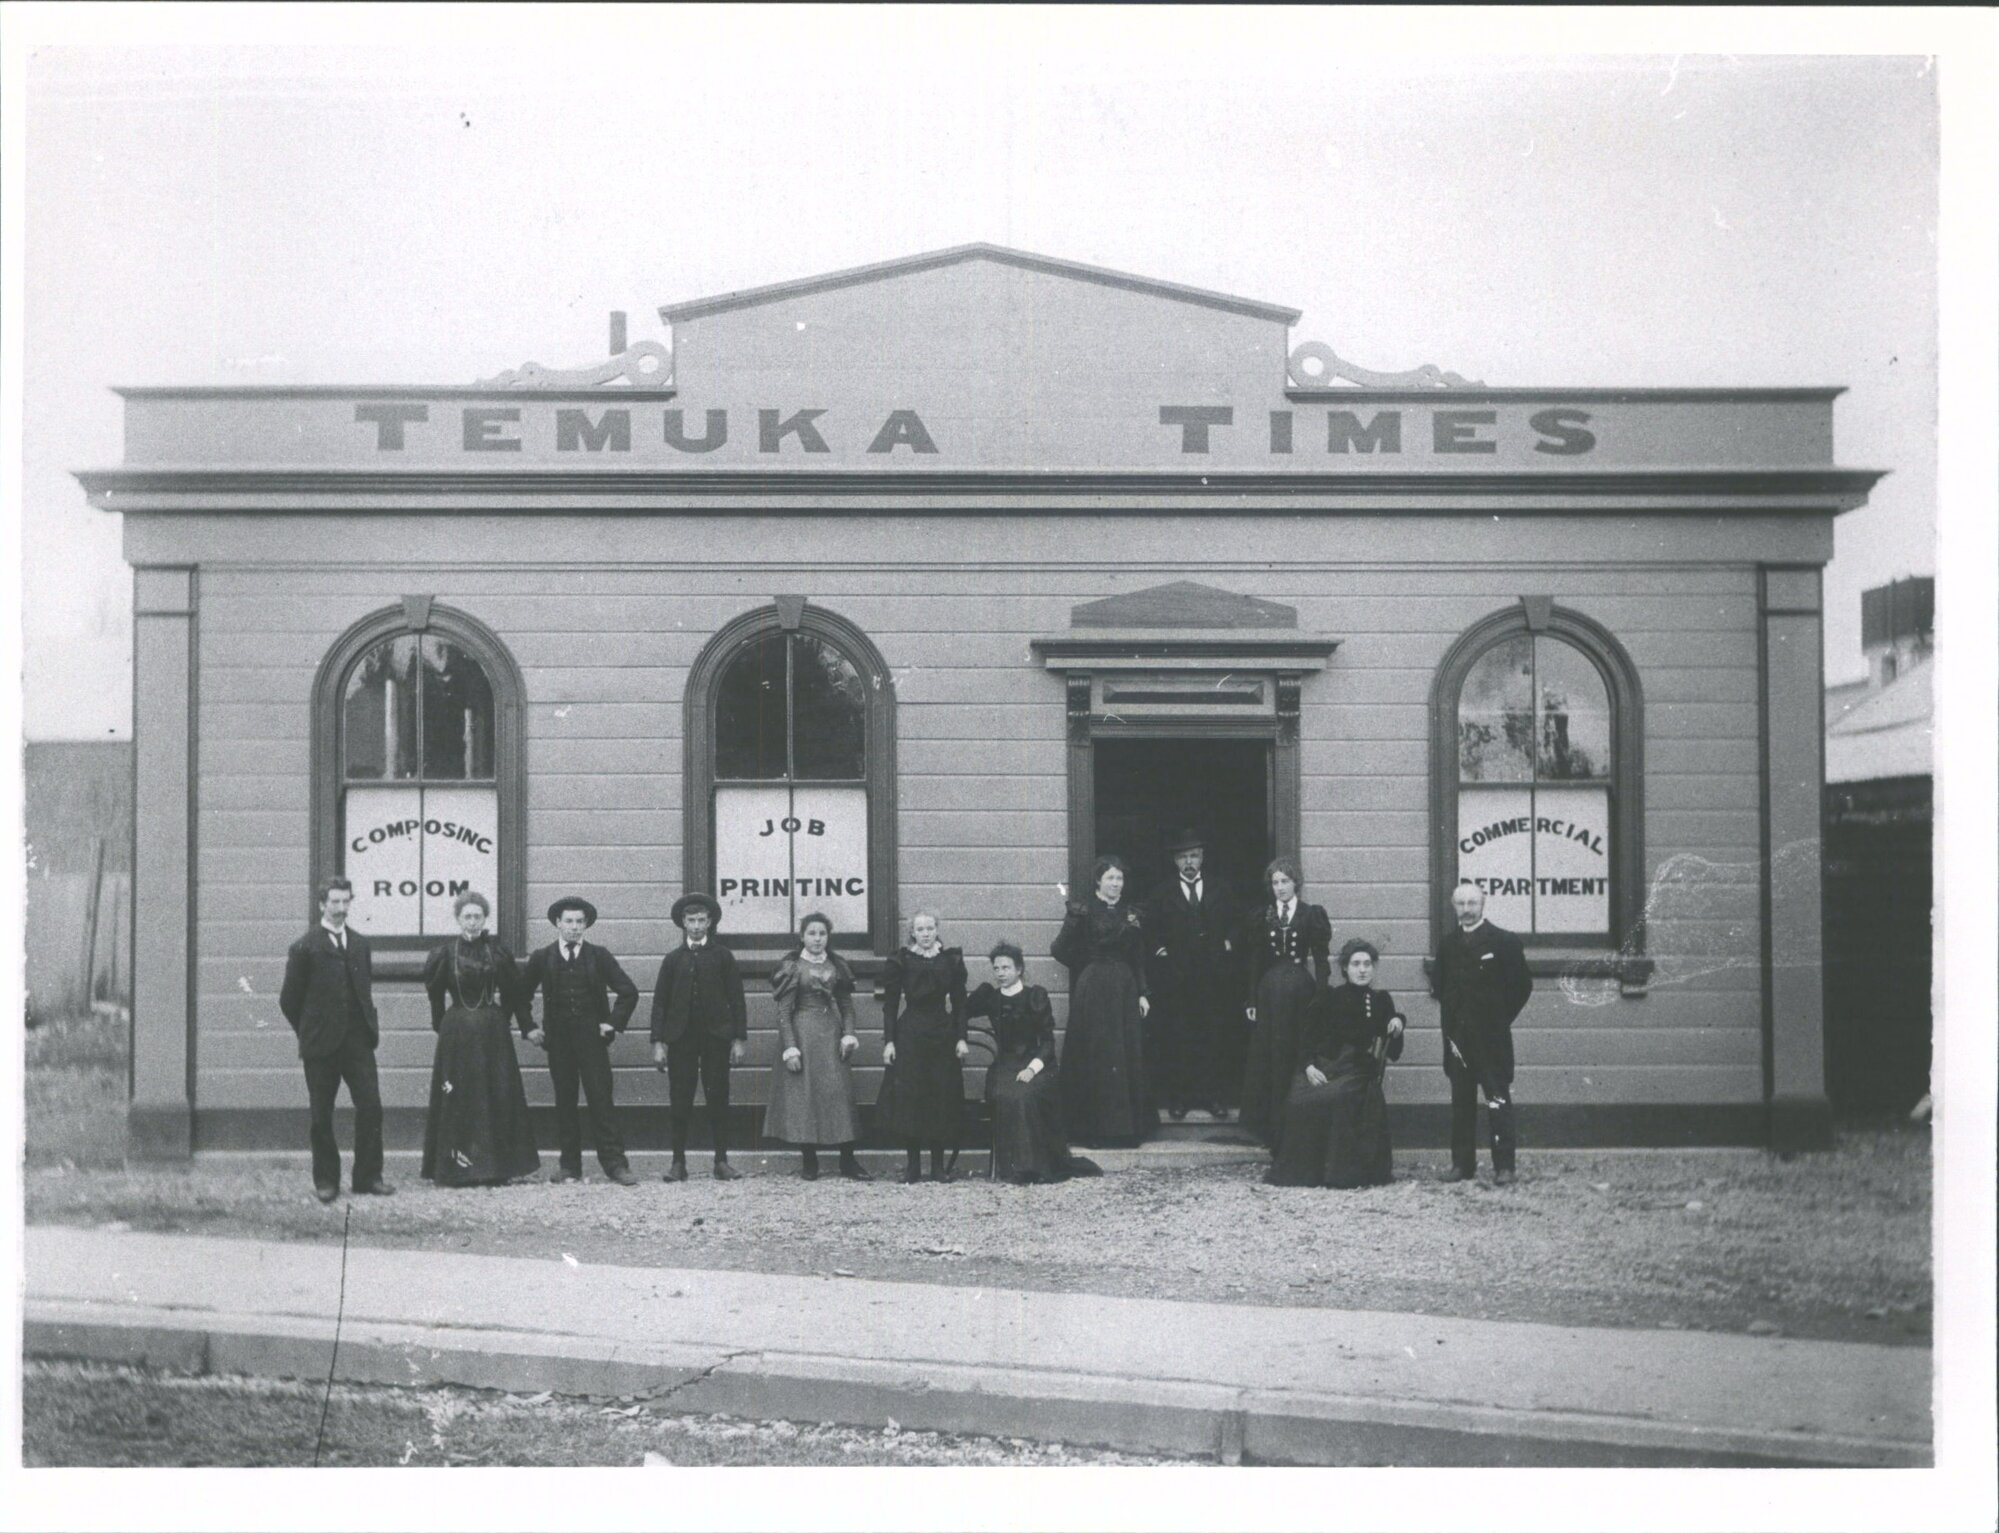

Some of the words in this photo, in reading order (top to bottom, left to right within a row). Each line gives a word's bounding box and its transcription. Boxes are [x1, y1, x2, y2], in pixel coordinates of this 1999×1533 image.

[354, 403, 939, 453] TEMUKA
[1159, 405, 1597, 456] TIMES
[759, 817, 826, 837] JOB
[1459, 817, 1604, 856] COMMERCIAL
[373, 880, 470, 897] ROOM
